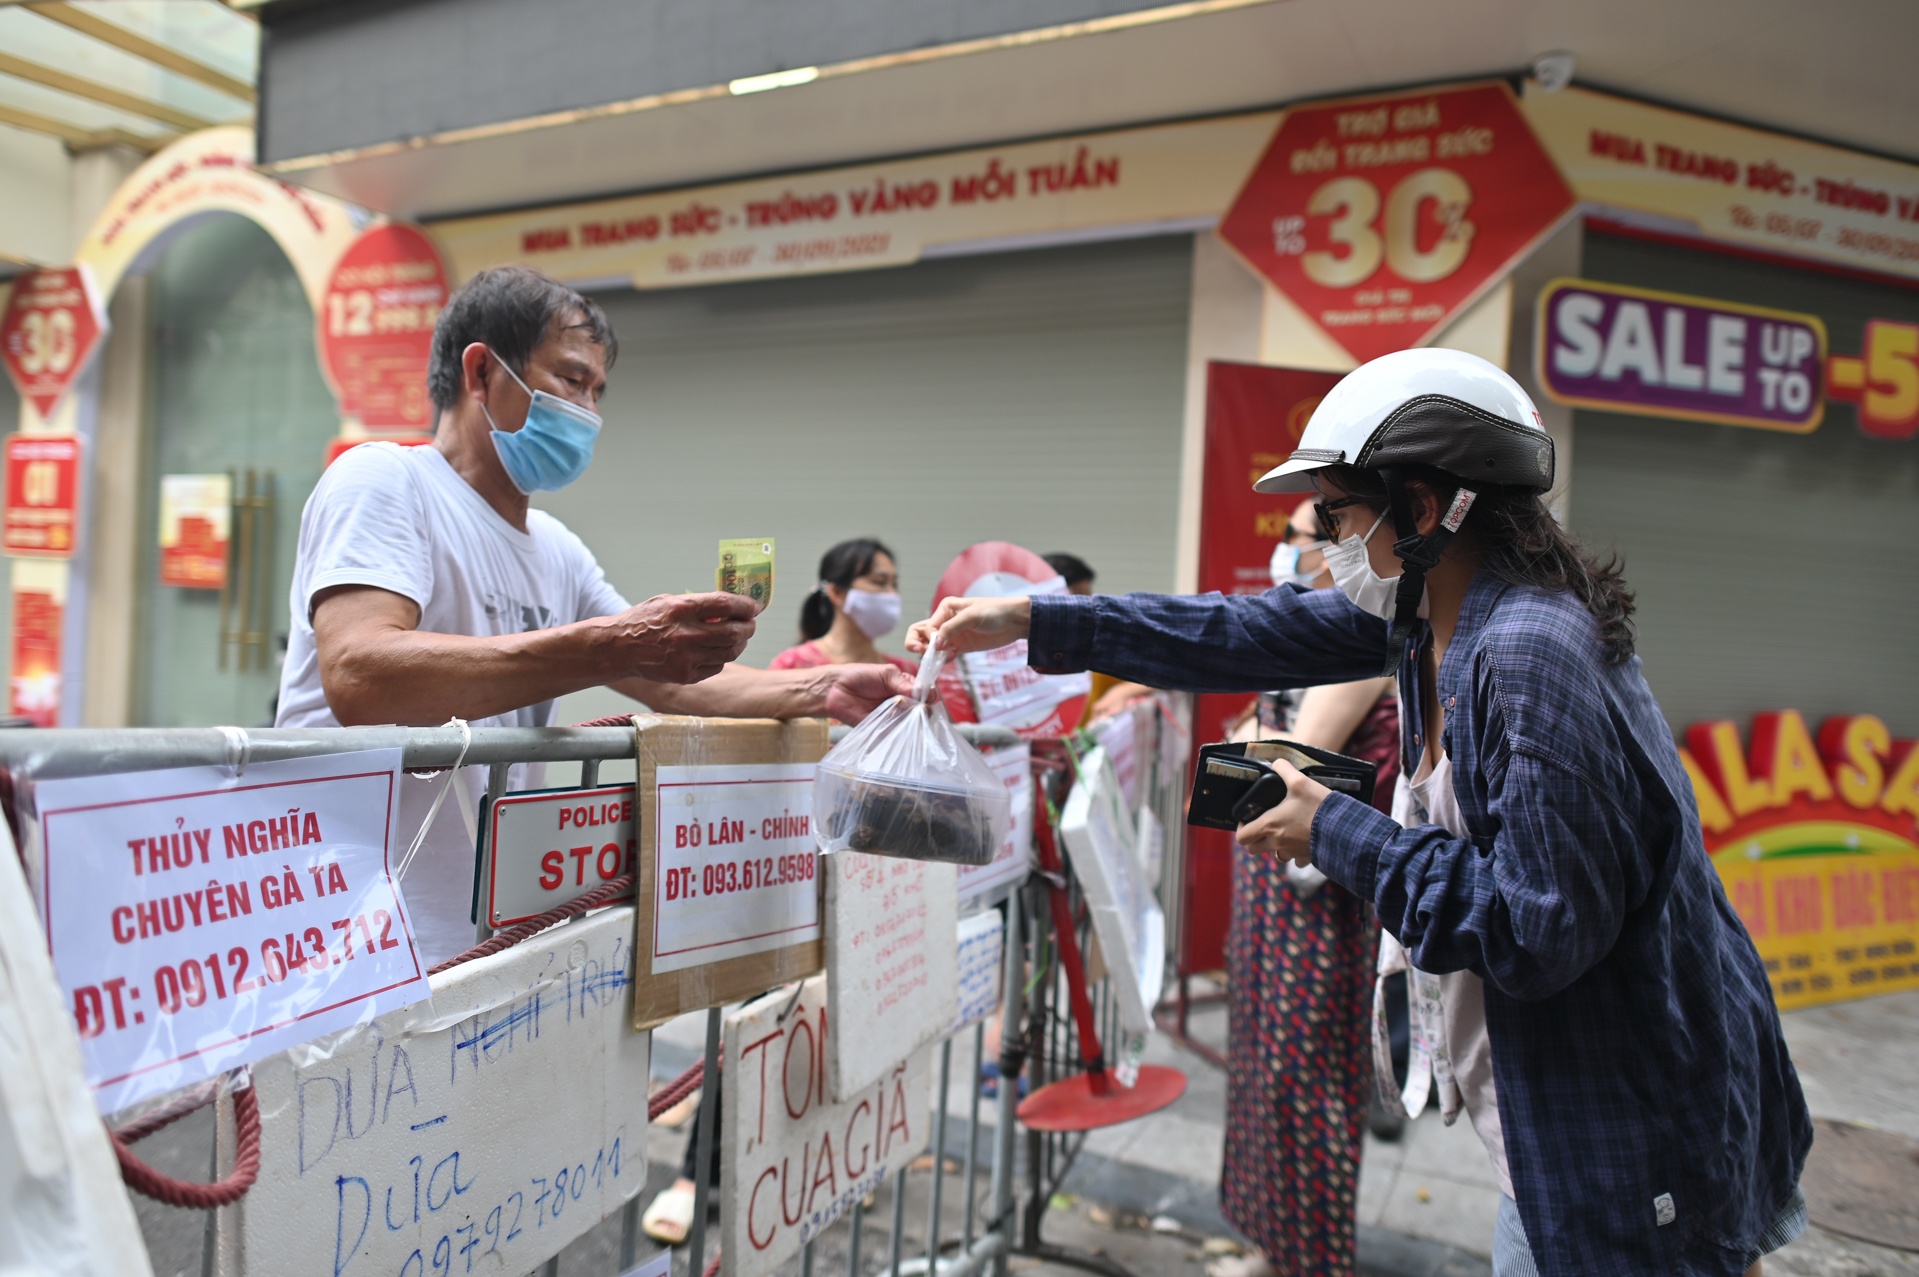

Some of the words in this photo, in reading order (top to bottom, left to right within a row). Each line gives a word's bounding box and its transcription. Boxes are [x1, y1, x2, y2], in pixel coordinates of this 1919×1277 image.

[1590, 129, 1647, 167] MUA
[1655, 142, 1738, 186] TRANG
[522, 227, 570, 252] MUA
[581, 215, 660, 246] TRANG
[670, 203, 720, 238] SỨC
[746, 189, 837, 228] TRÚNG
[849, 178, 939, 217] VÀNG
[1027, 145, 1119, 197] TUẦN
[1554, 292, 1747, 397] SALE
[1759, 322, 1814, 369] UP
[1757, 370, 1812, 415] TO
[1446, 494, 1471, 529] TOPCOM
[127, 816, 211, 876] THỦY
[222, 807, 322, 859] NGHĨA
[559, 801, 632, 830] POLICE
[675, 818, 702, 849] BÒ
[708, 816, 744, 846] LÂN
[762, 808, 809, 840] CHỈNH
[666, 865, 697, 901] ĐT:
[703, 852, 814, 896] 093.612.9598
[111, 879, 252, 945] CHUYÊN
[260, 865, 305, 910] GÀ
[308, 862, 349, 899] TA
[73, 976, 145, 1041] ĐT:
[154, 909, 399, 1016] 0912.643.712
